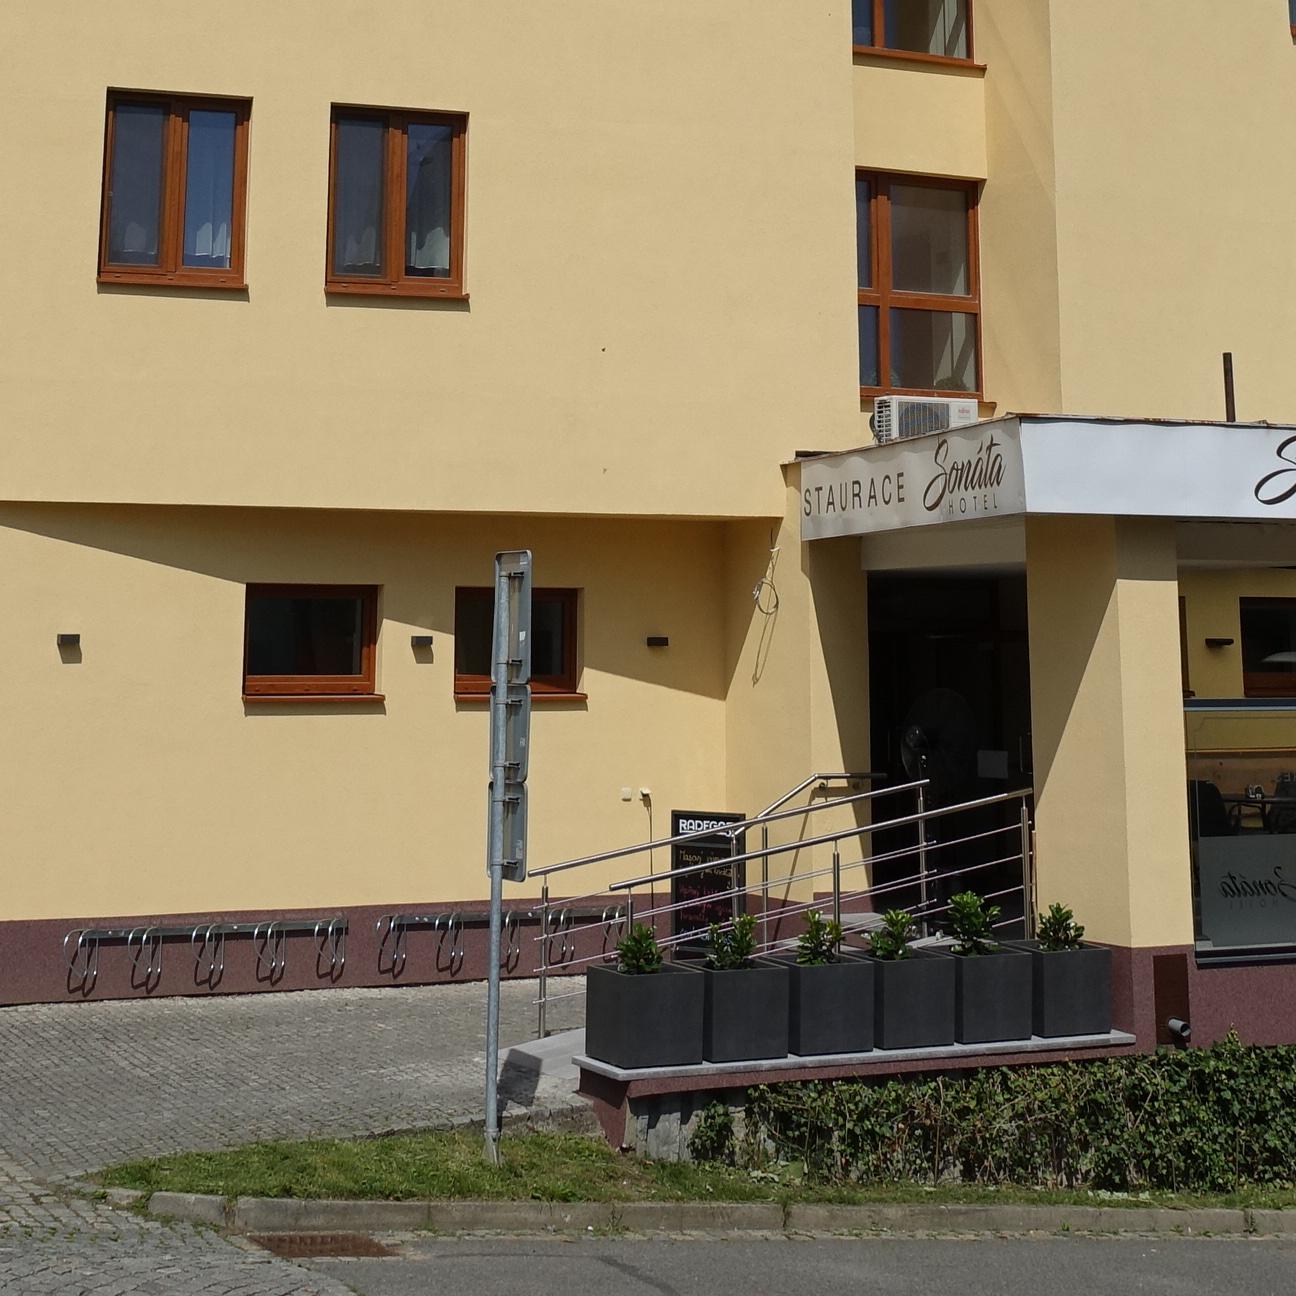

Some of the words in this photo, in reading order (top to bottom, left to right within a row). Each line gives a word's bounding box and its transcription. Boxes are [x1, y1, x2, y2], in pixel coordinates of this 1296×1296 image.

[803, 471, 905, 517] STAURACE
[923, 433, 1007, 512] Sonáta
[948, 493, 998, 515] HOTEL
